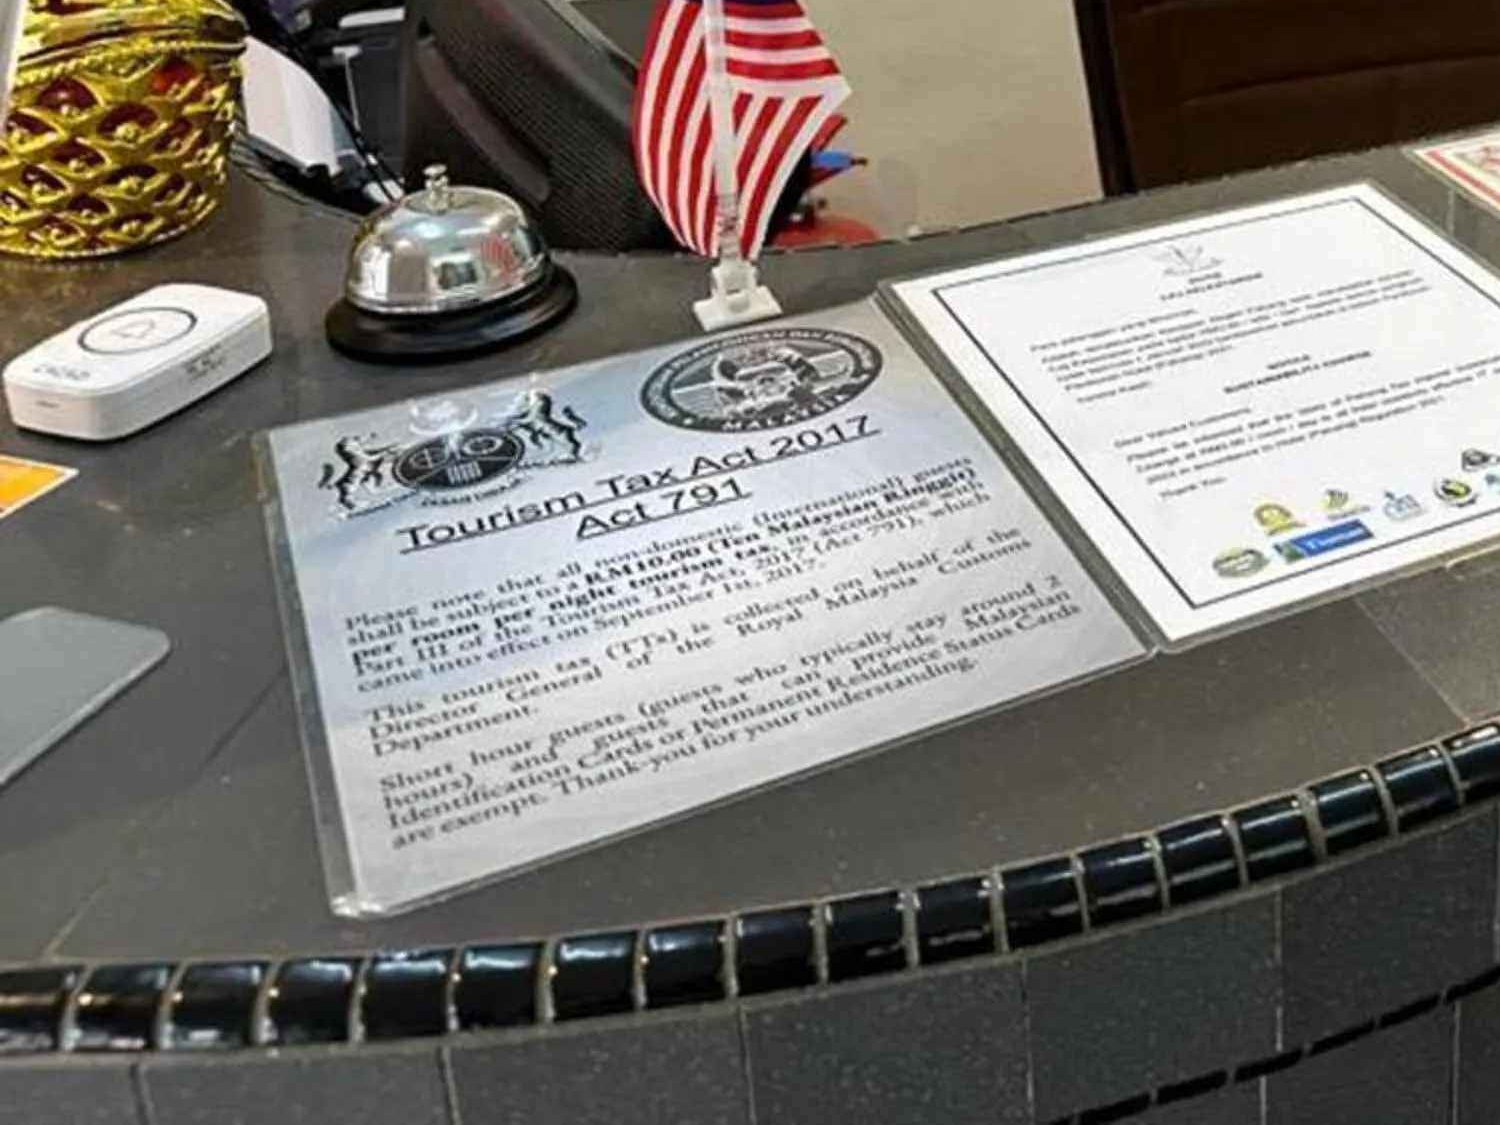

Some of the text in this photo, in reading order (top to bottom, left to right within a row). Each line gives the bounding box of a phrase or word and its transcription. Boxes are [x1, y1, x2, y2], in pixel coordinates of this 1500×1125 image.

[396, 489, 587, 549] Tourism
[595, 467, 673, 500] Tax
[689, 445, 758, 478] Act
[769, 414, 870, 458] 2017
[575, 477, 746, 541] Act 791
[347, 621, 404, 647] shall
[409, 615, 441, 633] be
[535, 583, 561, 600] to
[566, 580, 579, 592] a
[766, 500, 879, 538] Malaysian
[347, 606, 420, 632] Please
[432, 589, 487, 612] note
[497, 573, 546, 595] that
[557, 560, 583, 579] all
[352, 640, 398, 668] per
[410, 620, 481, 648] room
[493, 606, 536, 630] per
[549, 584, 616, 611] night
[628, 556, 724, 590] tourism
[787, 532, 809, 547] in
[357, 666, 425, 694] came
[428, 653, 482, 675] into
[485, 633, 553, 662] effect
[555, 624, 590, 642] on
[593, 588, 716, 629] September
[364, 699, 426, 723] This
[441, 668, 541, 704] tourism
[554, 655, 592, 674] tax
[690, 621, 711, 636] is
[722, 586, 821, 627] collected
[832, 576, 863, 594] on
[872, 551, 940, 581] behalf
[952, 539, 976, 556] of
[986, 527, 1023, 545] the
[369, 538, 1033, 740] Director General of the Royal Malaysia Customs
[457, 631, 487, 652] of
[493, 623, 533, 642] the
[539, 594, 641, 627] Tourism
[653, 580, 691, 599] Tax
[373, 704, 540, 758] Department.
[379, 574, 1063, 794] Short hour guests (guests who typically stay around 2
[384, 588, 1073, 811] hours) and guests that can provide Malaysian
[388, 602, 1083, 829] Identification Cards or Permanent Residence Status Cards
[392, 826, 435, 850] are
[700, 728, 739, 751] for
[743, 711, 802, 743] your
